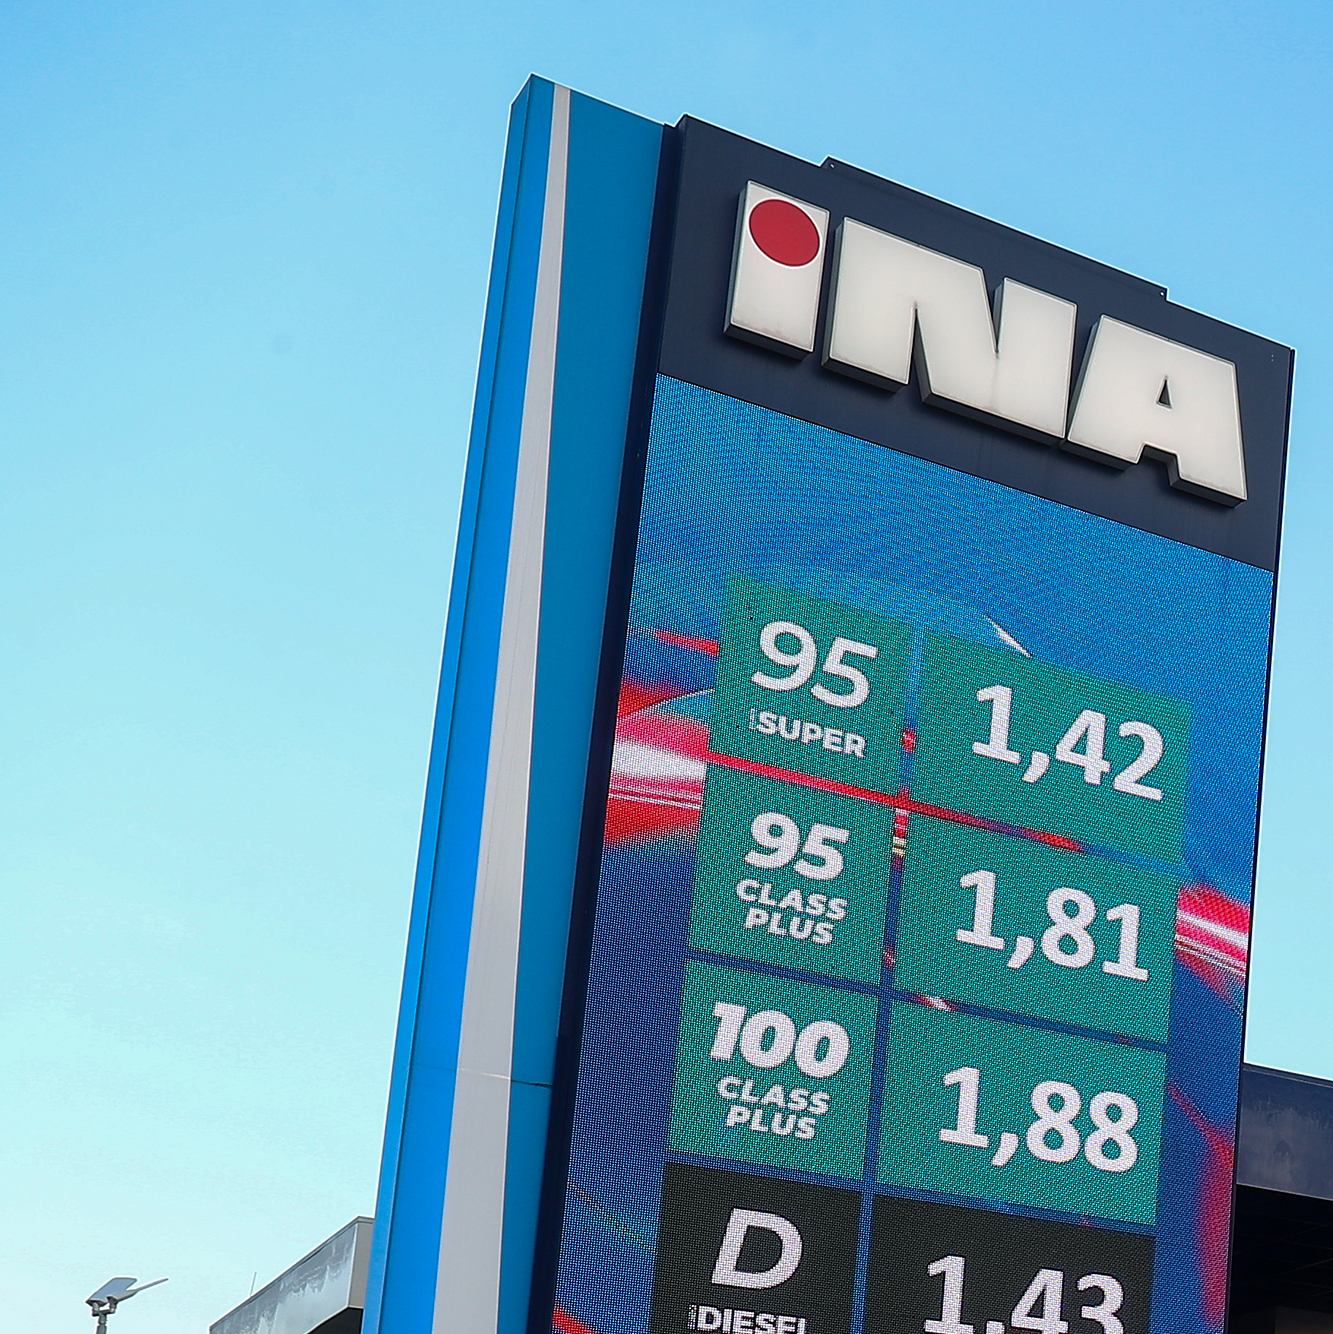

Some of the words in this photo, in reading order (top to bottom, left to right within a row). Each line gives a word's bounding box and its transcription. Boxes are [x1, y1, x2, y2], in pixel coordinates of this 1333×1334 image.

[751, 620, 879, 709] 95
[971, 684, 1165, 801] 1,42
[756, 710, 866, 758] SUPER
[736, 879, 849, 921] CLASS
[743, 811, 851, 881] 95
[956, 868, 1149, 982] 1,81
[743, 907, 836, 946] PLUS
[709, 1001, 851, 1079] 100
[938, 1066, 1140, 1174] 1,88
[717, 1074, 831, 1115] CLASS
[724, 1104, 817, 1141] PLUS
[710, 1207, 803, 1290] D
